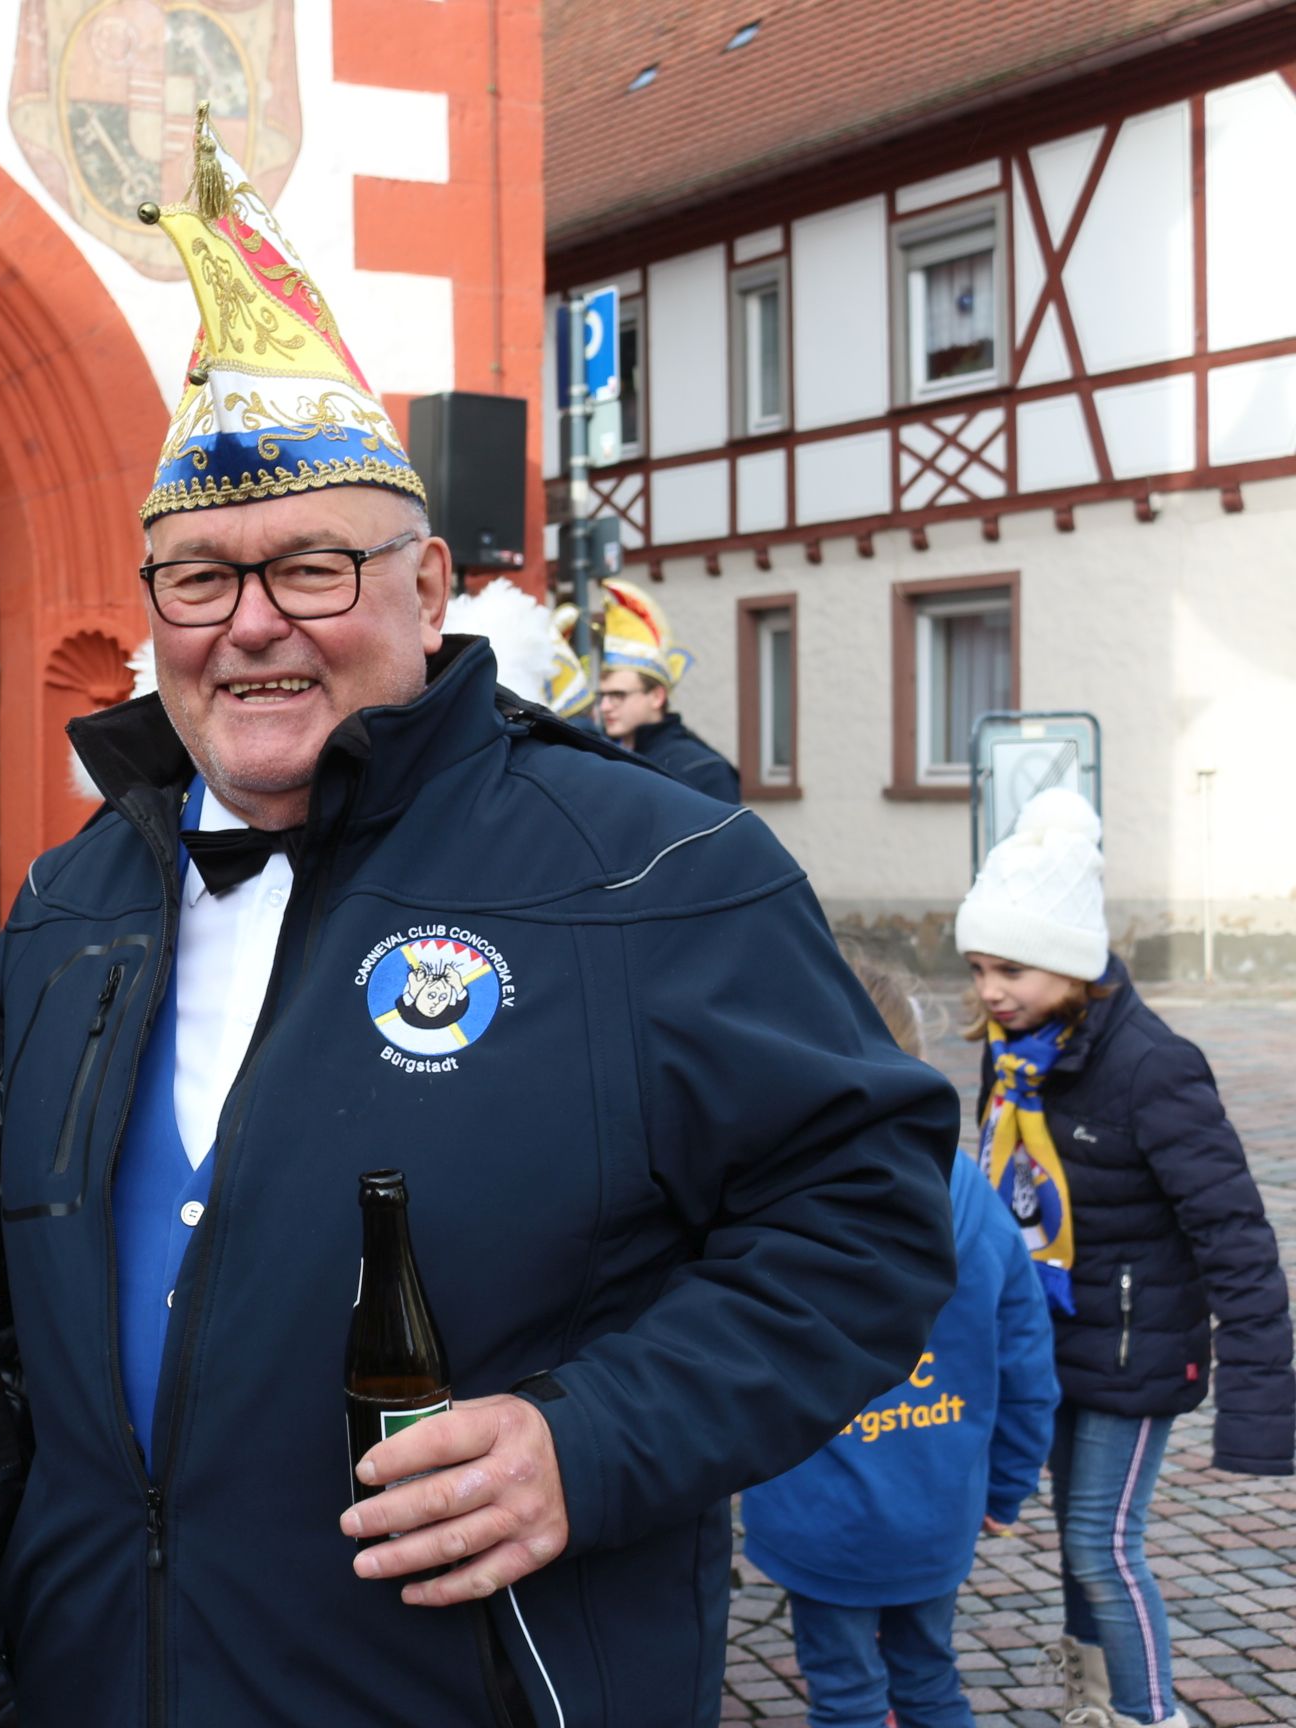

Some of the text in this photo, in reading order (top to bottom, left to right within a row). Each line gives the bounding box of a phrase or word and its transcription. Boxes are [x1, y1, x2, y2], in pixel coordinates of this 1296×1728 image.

[354, 924, 516, 1008] CARNEVAL CLUB CONCORDIA E.V.
[380, 1045, 459, 1073] Bürgstadt
